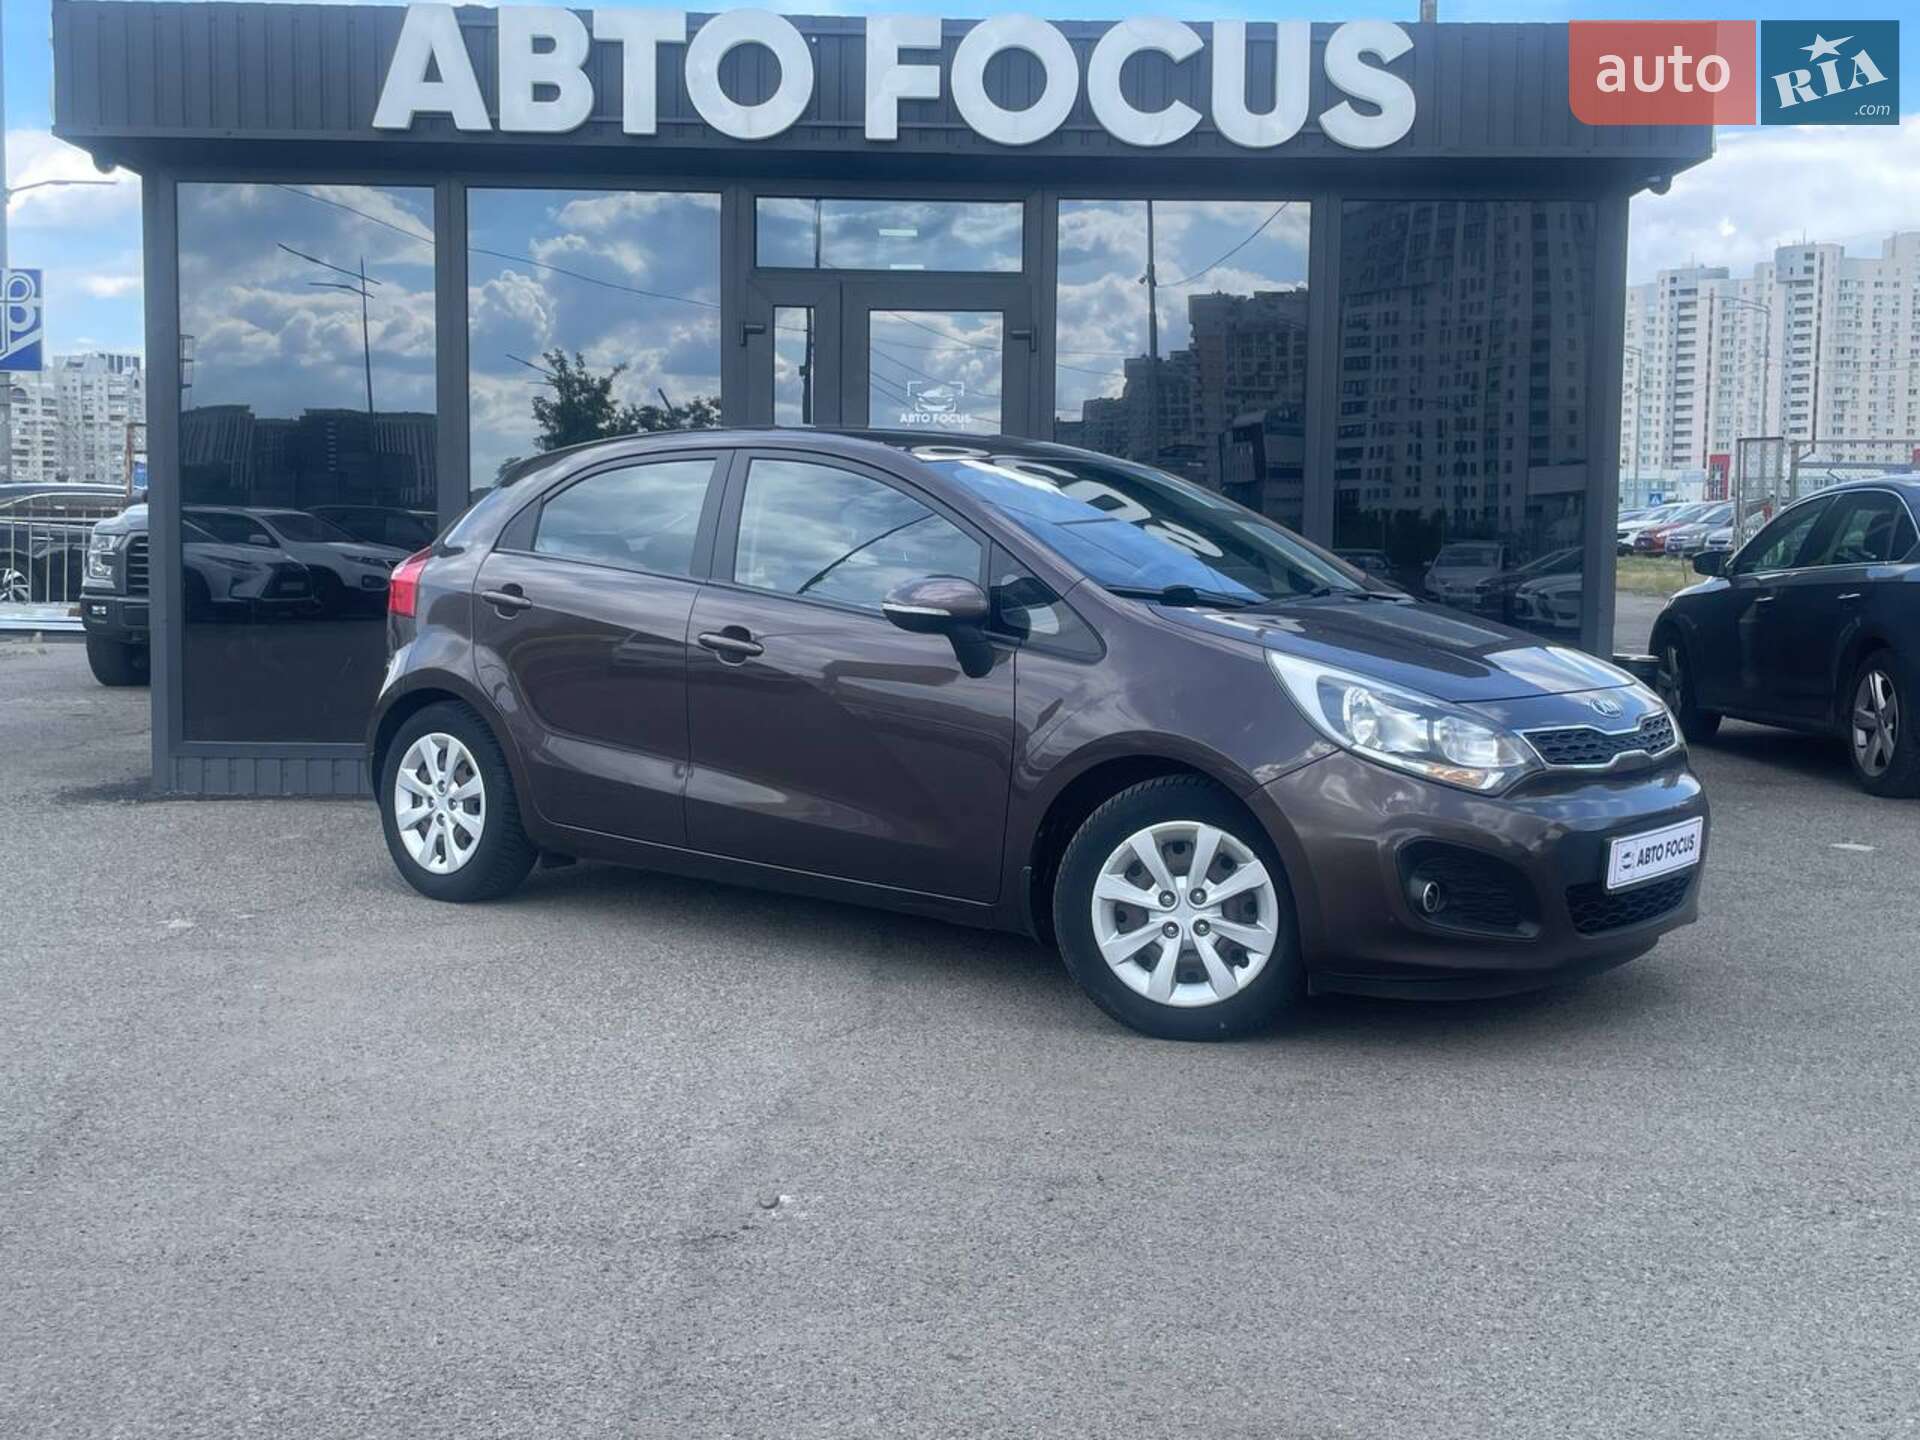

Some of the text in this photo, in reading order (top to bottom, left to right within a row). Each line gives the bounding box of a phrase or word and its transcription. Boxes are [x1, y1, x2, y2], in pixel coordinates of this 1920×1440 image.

[372, 4, 1418, 149] АВТО FOCUS
[900, 413, 972, 423] АВТО FOCUS
[1636, 834, 1695, 867] АВТО FOCUS
